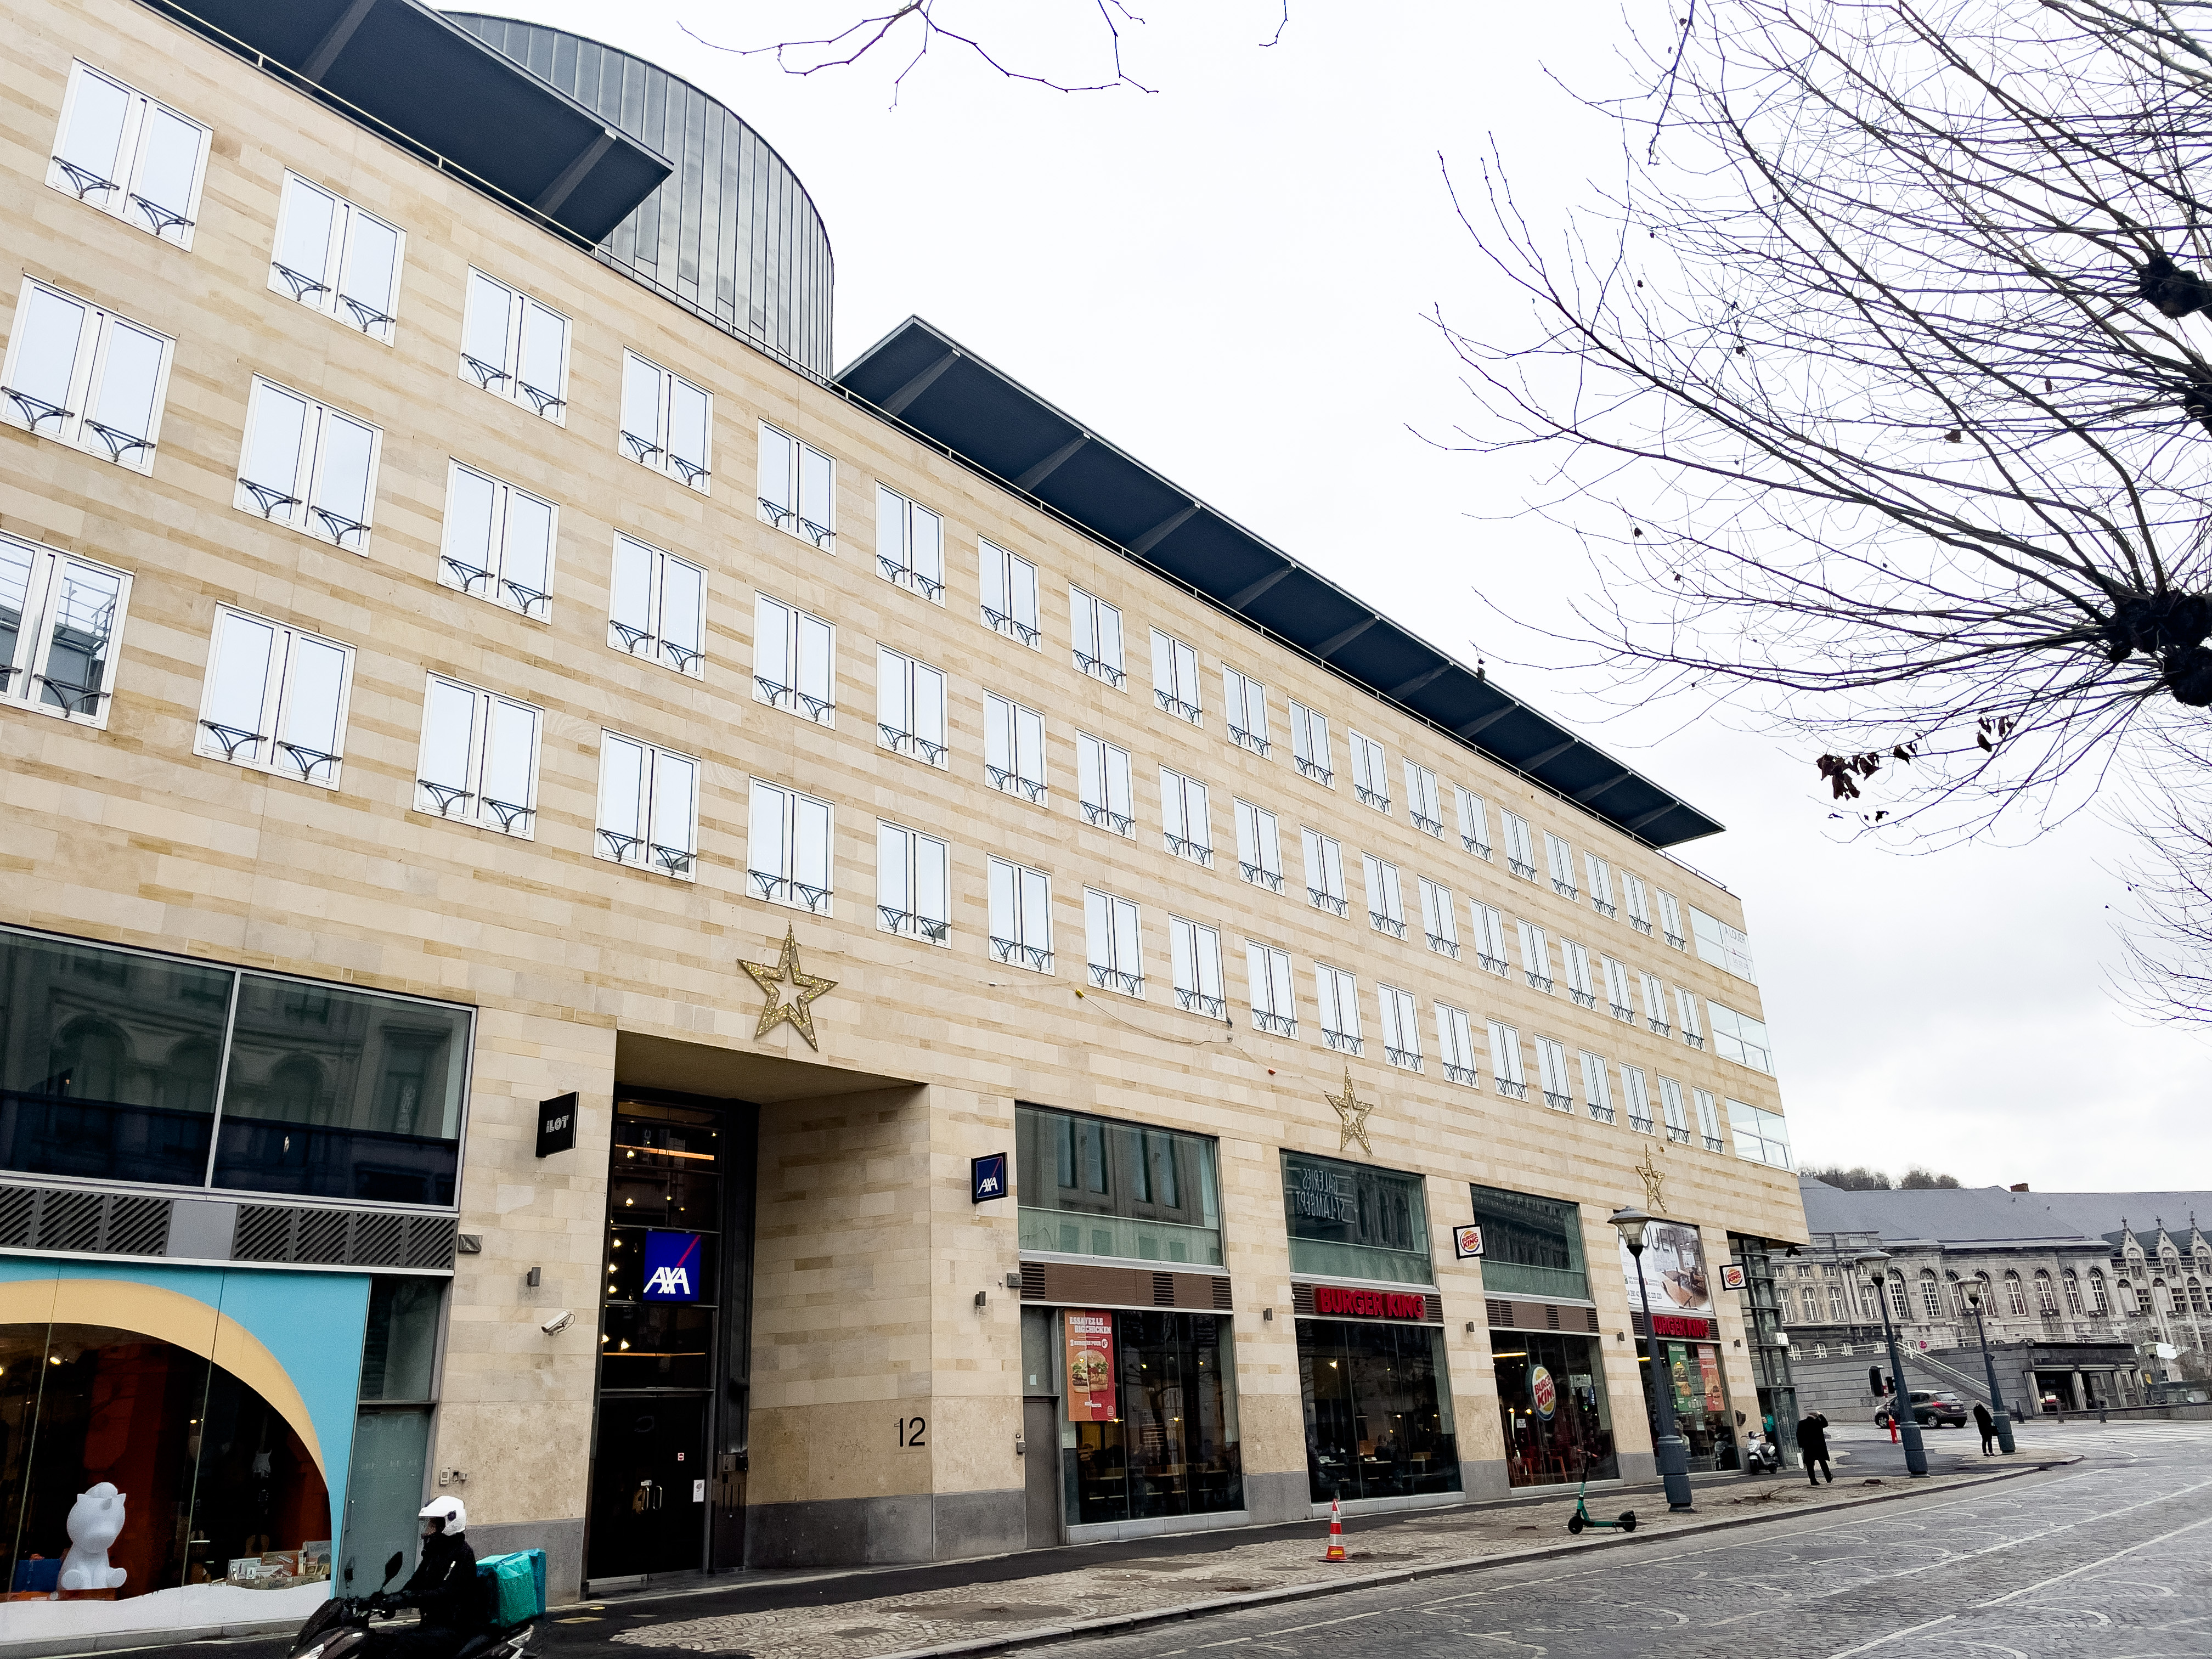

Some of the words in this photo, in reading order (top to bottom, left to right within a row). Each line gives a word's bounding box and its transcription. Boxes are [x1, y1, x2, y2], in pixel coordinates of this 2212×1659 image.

[1729, 928, 1746, 945] LOUER
[978, 1177, 998, 1194] AXA
[1462, 1233, 1477, 1243] BURGER
[1463, 1237, 1479, 1249] KING
[1642, 1226, 1678, 1254] OUER
[643, 1267, 691, 1294] AXA
[1729, 1273, 1741, 1283] KING
[1317, 1288, 1384, 1316] BURGER
[1383, 1293, 1425, 1318] KING
[1652, 1316, 1686, 1336] URGER
[1686, 1319, 1708, 1338] KING
[898, 1417, 926, 1447] 12
